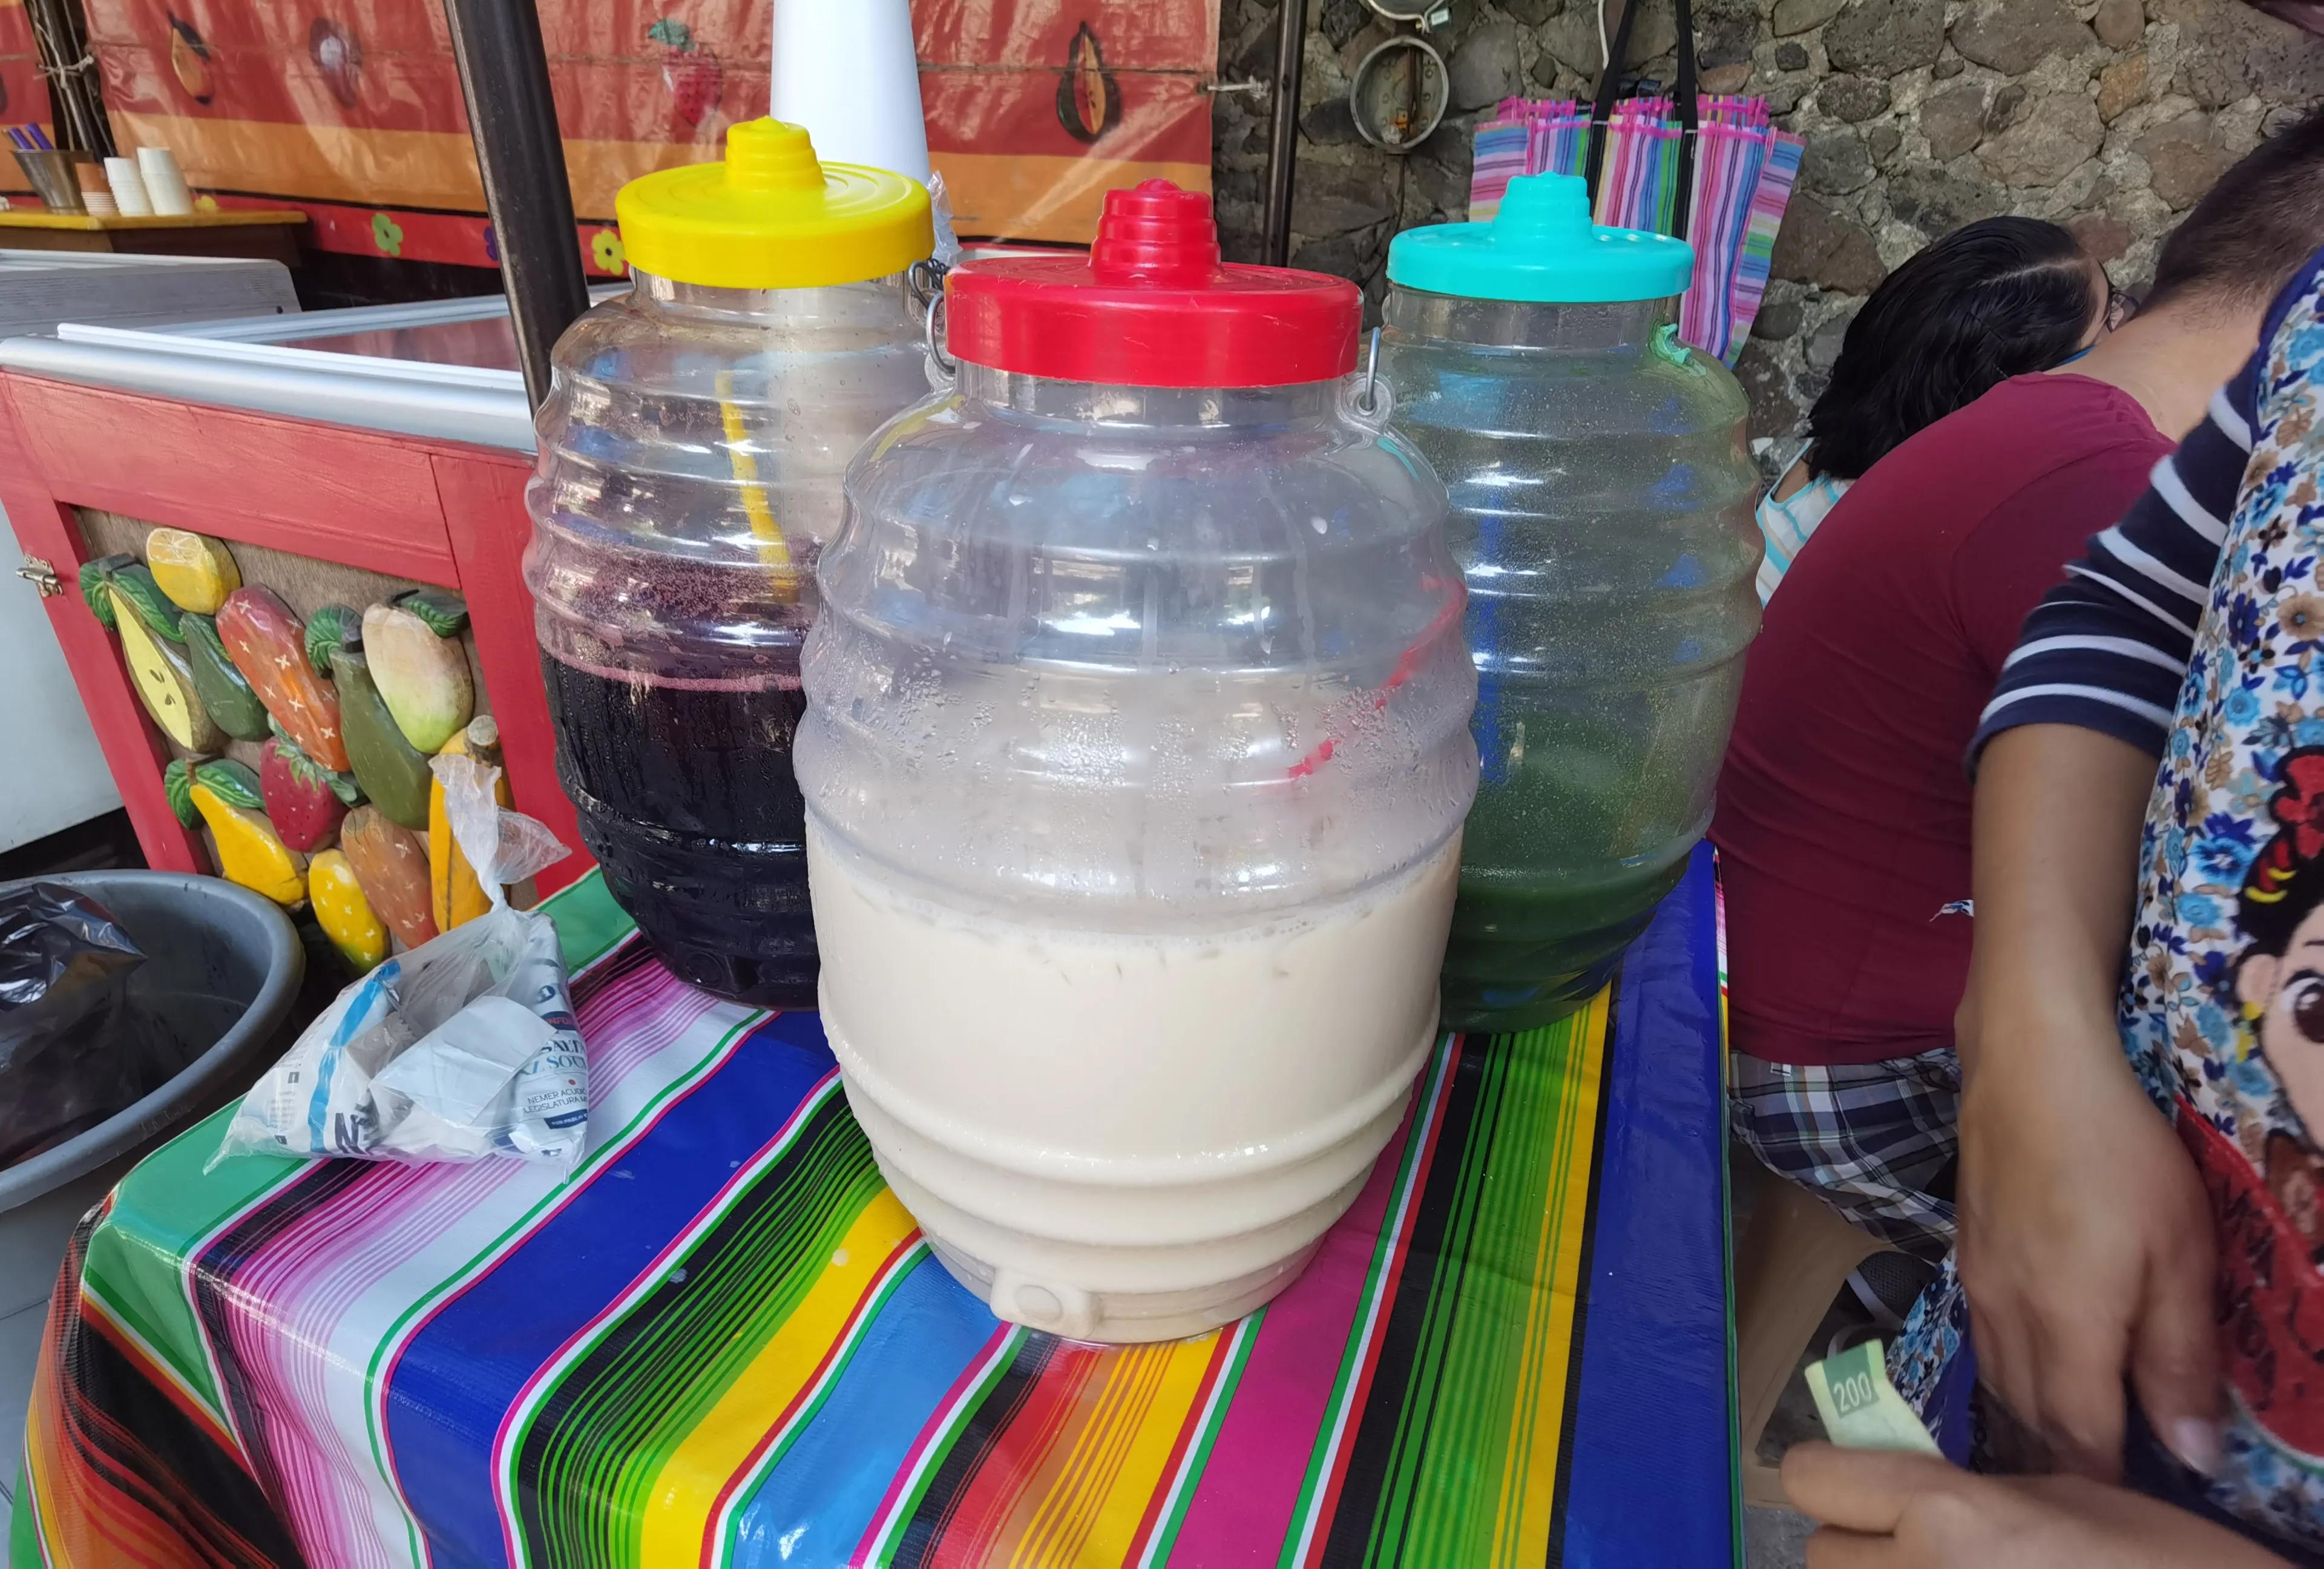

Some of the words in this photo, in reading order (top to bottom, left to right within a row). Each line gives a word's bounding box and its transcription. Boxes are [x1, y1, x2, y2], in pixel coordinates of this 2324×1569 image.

[524, 1097, 579, 1113] LEGISLATURA
[527, 1091, 559, 1104] NEMER
[1833, 1372, 1871, 1413] 200
